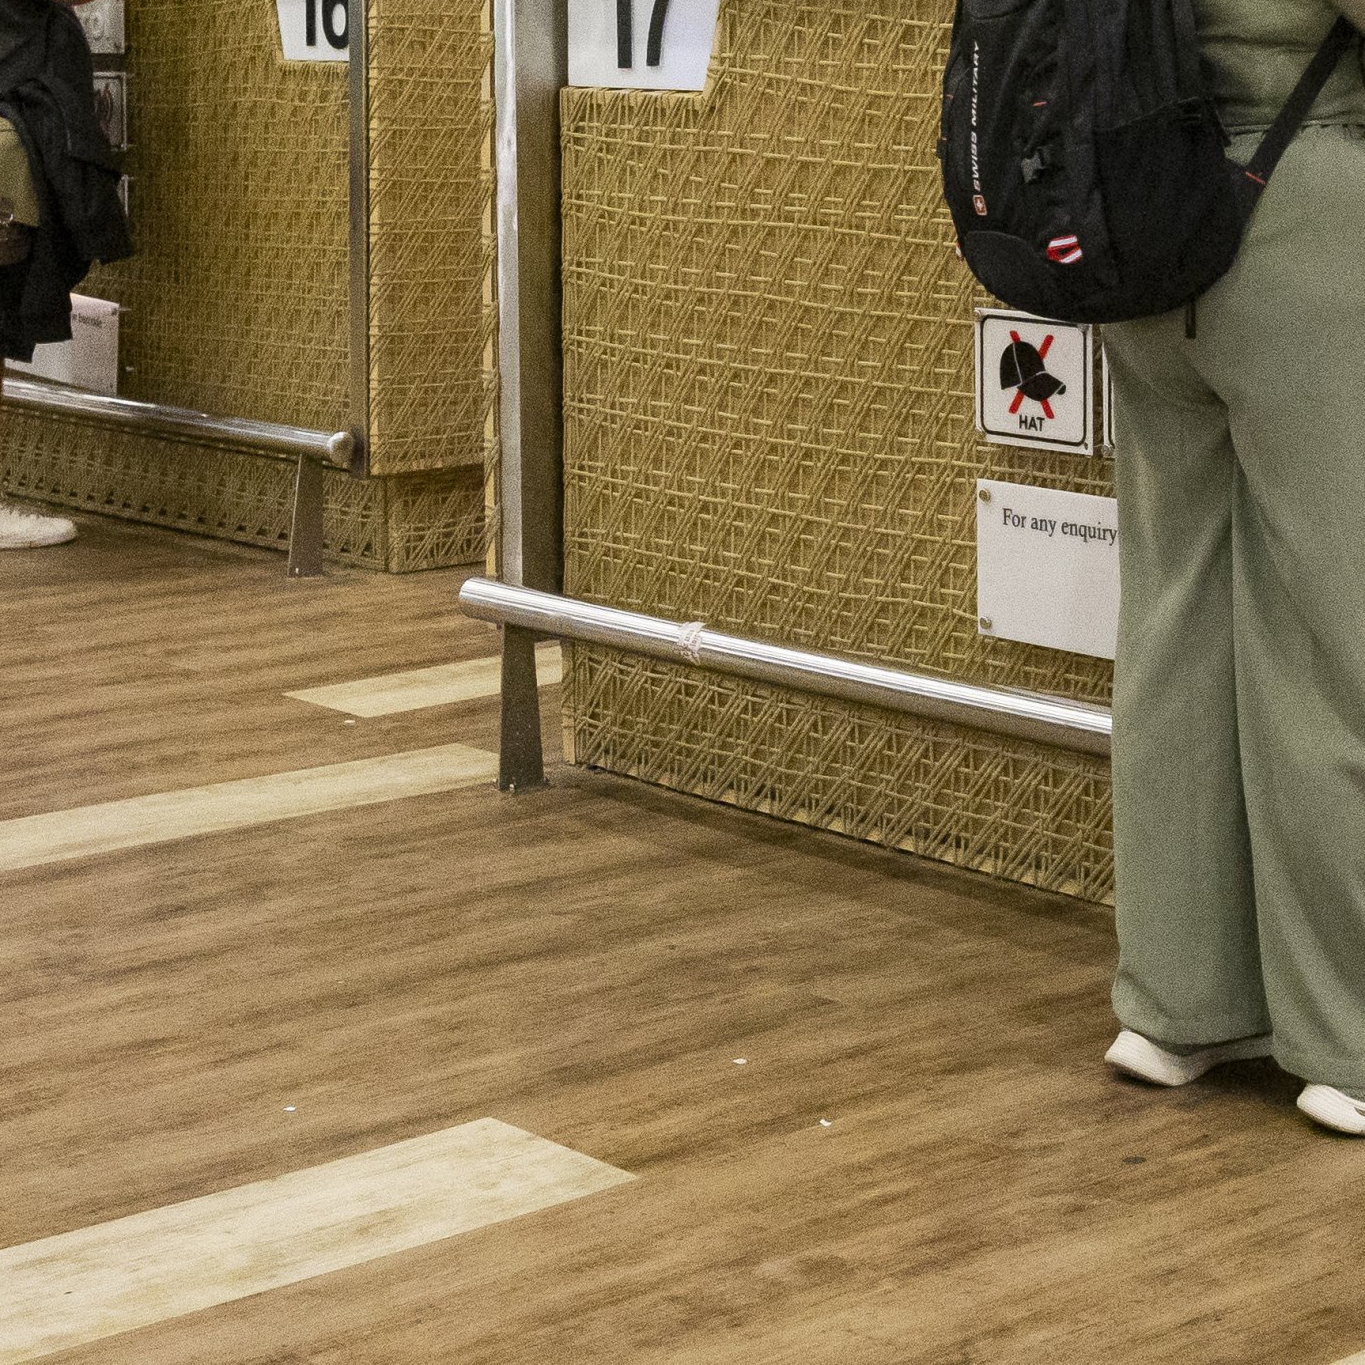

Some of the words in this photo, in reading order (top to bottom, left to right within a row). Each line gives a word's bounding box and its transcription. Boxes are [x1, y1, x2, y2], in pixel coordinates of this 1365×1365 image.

[971, 40, 980, 126] MILITARY
[970, 131, 981, 192] SWISS
[1018, 414, 1045, 432] HAT
[1002, 508, 1027, 529] For
[1031, 516, 1057, 537] any
[1061, 518, 1118, 546] enquiry
